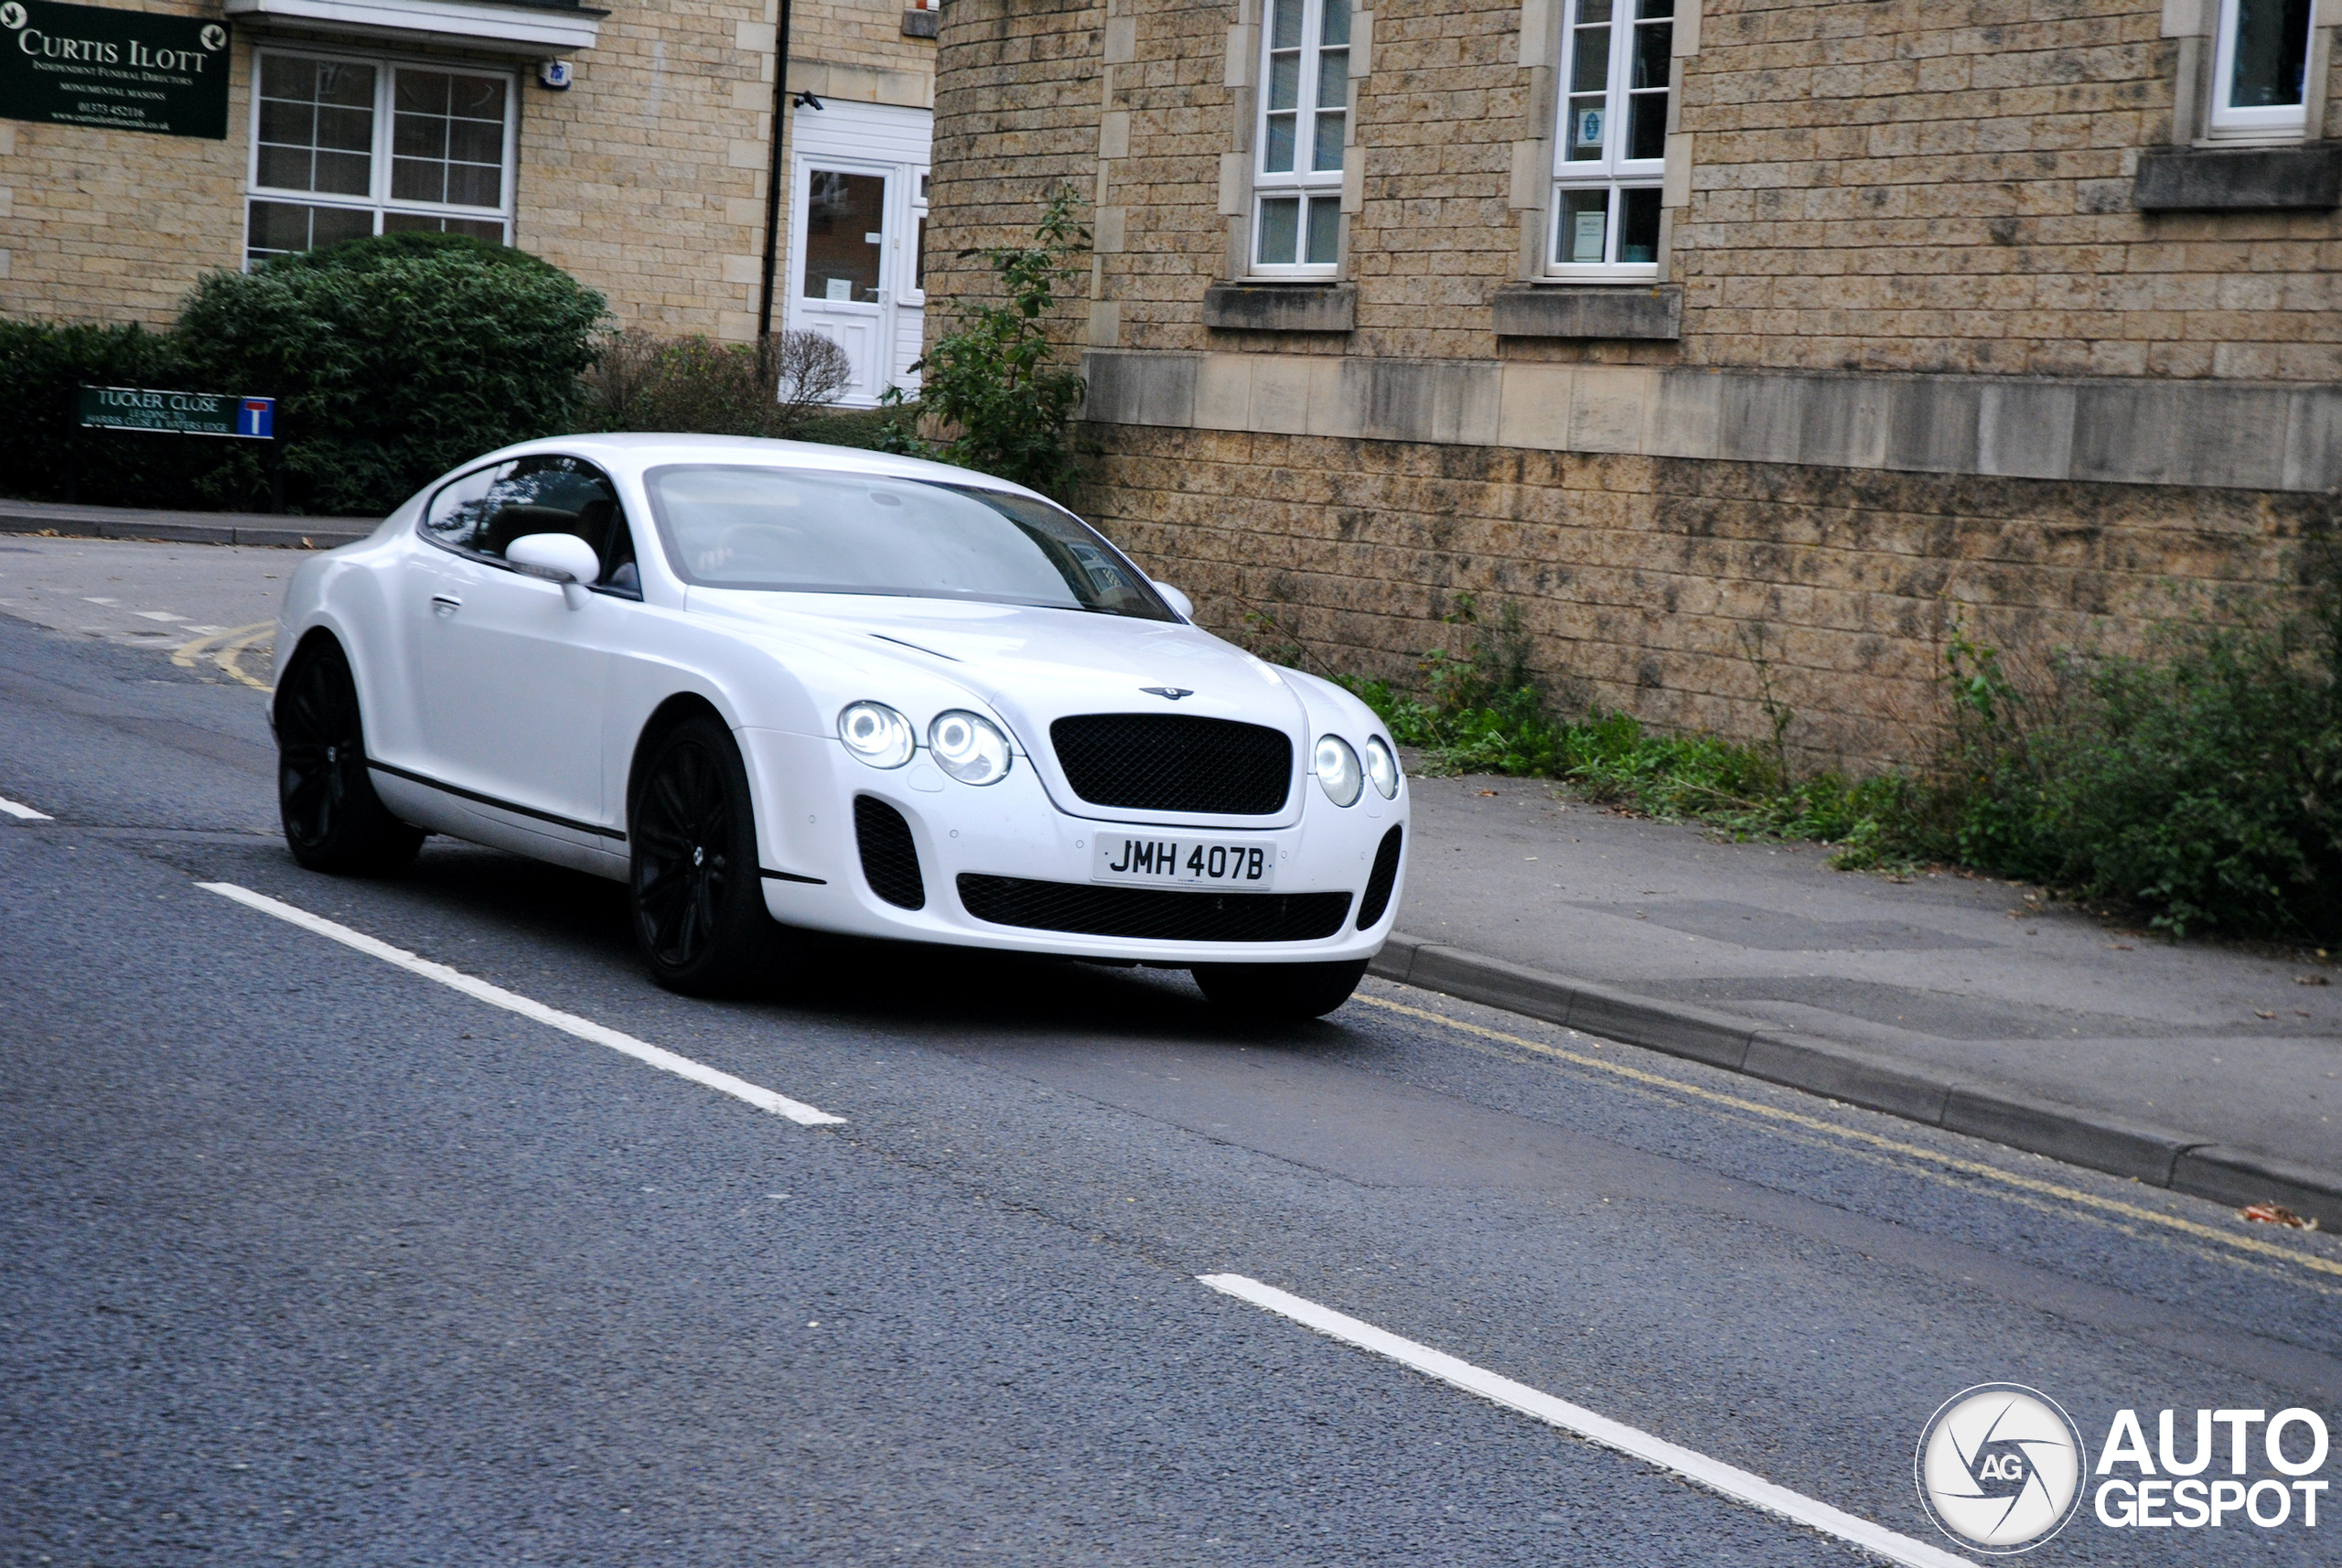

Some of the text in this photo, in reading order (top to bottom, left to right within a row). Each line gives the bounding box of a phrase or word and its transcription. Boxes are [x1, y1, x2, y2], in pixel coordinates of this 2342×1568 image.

[18, 28, 208, 73] CURTIS ILOTT
[32, 59, 194, 86] INDEPENDENT FUNERAL DIRECTORS
[98, 391, 220, 413] TUCKER CLOSE
[124, 416, 153, 428] CLOSE
[204, 423, 228, 432] EDGE
[129, 410, 187, 421] LEADING TO
[1110, 840, 1264, 880] JMH 407B
